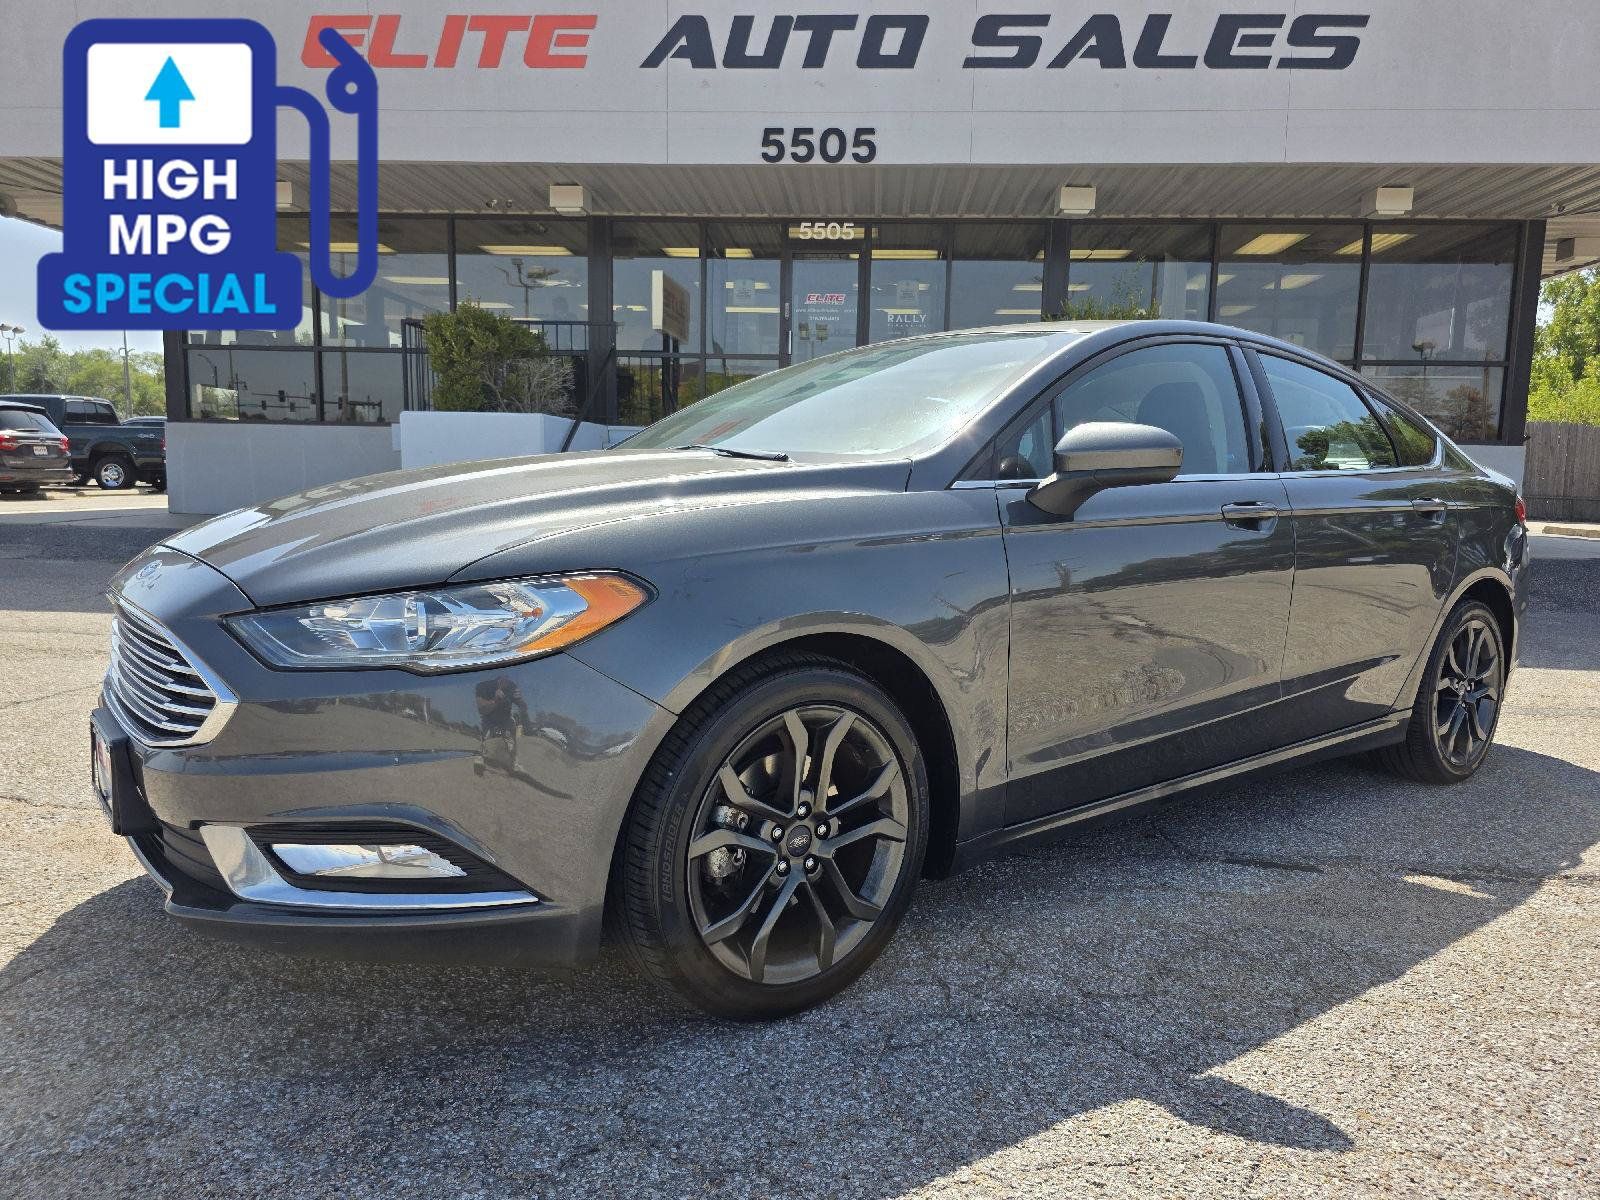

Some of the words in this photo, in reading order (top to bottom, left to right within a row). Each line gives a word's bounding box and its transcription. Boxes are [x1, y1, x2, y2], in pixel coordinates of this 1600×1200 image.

[302, 14, 597, 69] ELITE
[640, 13, 931, 69] AUTO
[962, 13, 1371, 70] SALES
[761, 127, 877, 164] 5505
[799, 222, 855, 240] 5505
[807, 294, 845, 302] ELITE
[887, 314, 927, 323] RALLY
